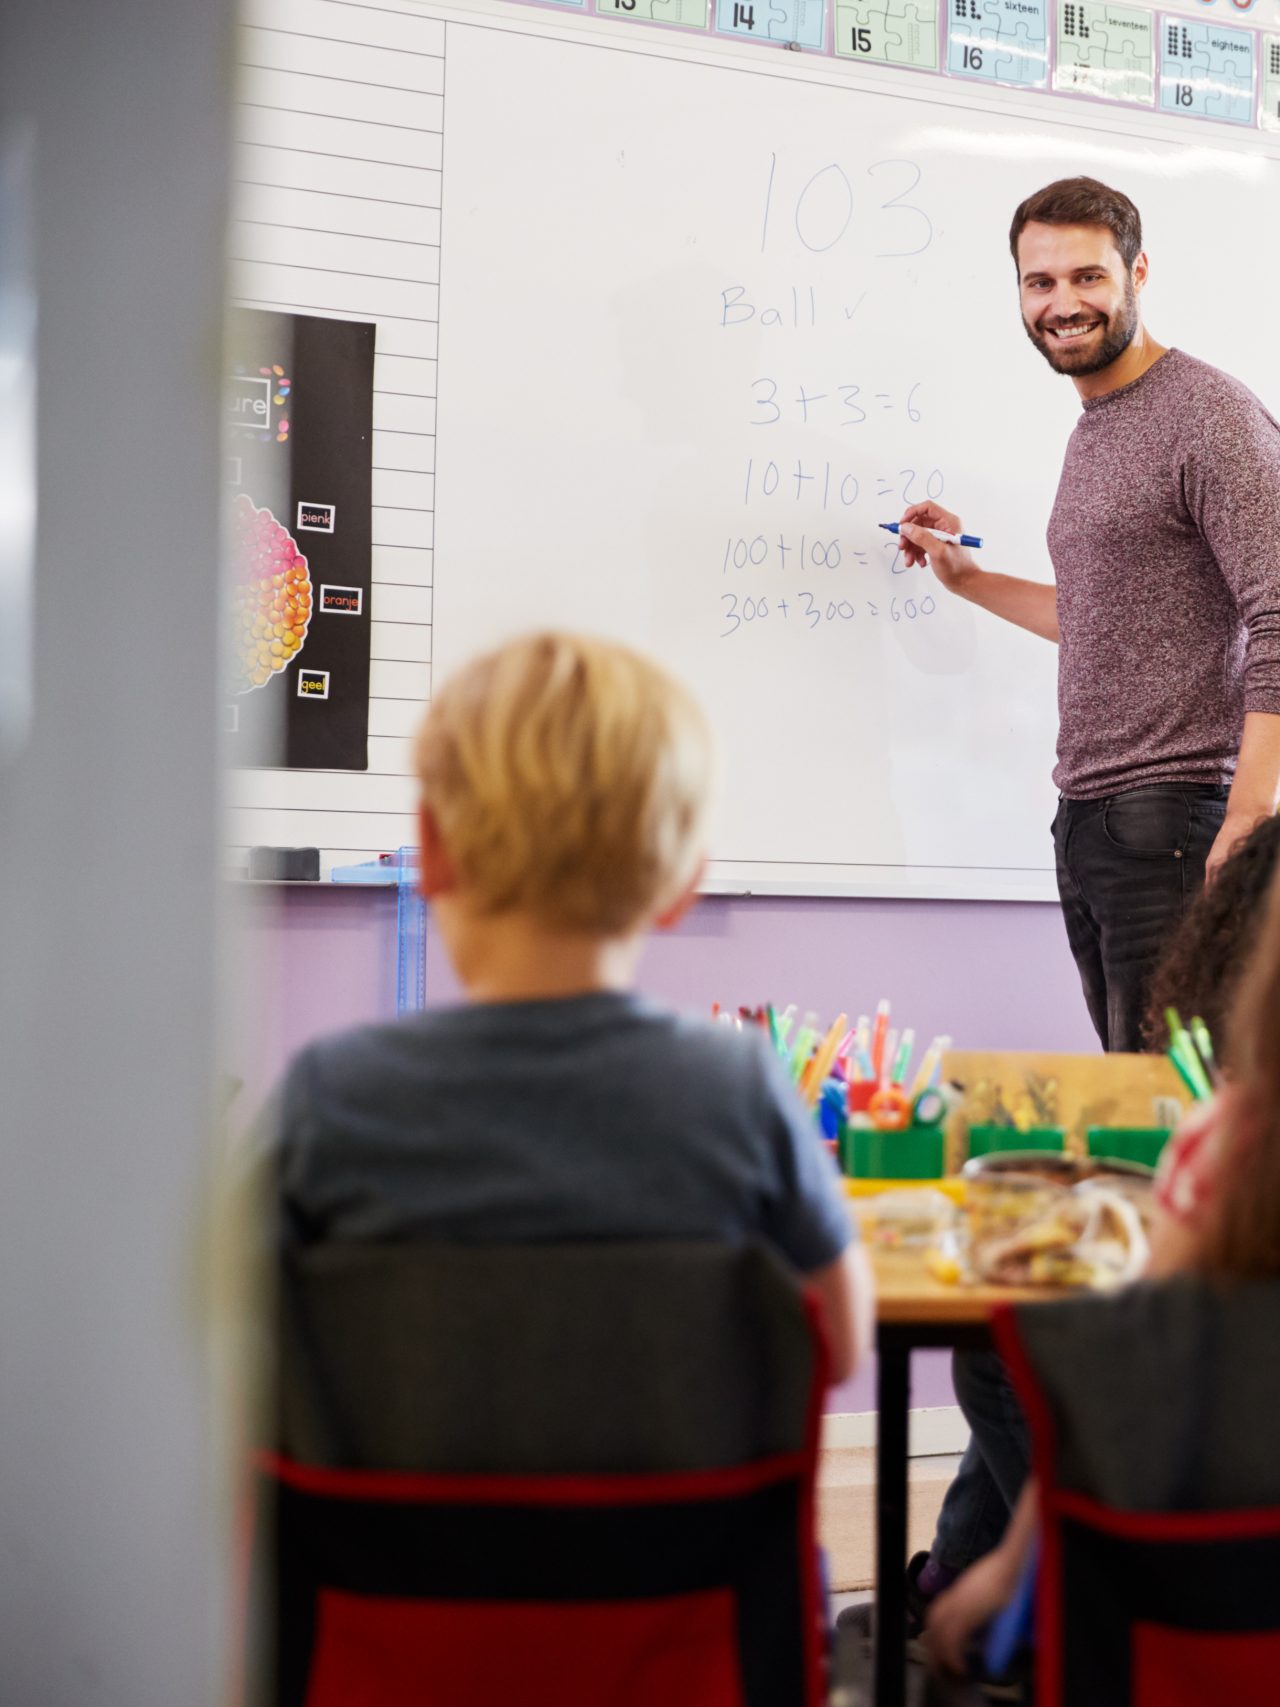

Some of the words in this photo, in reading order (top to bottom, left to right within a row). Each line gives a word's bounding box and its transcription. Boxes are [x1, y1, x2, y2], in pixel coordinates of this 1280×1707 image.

[733, 3, 755, 31] 14
[1004, 0, 1039, 15] sixteen
[1108, 18, 1148, 32] seventeen
[851, 27, 872, 53] 15
[1211, 39, 1250, 54] eighteen
[963, 45, 983, 71] 16
[1175, 83, 1194, 107] 18
[761, 152, 933, 260] 103
[718, 286, 815, 330] Ball
[300, 511, 331, 528] pienk
[323, 595, 359, 611] oranje
[301, 679, 325, 694] geel
